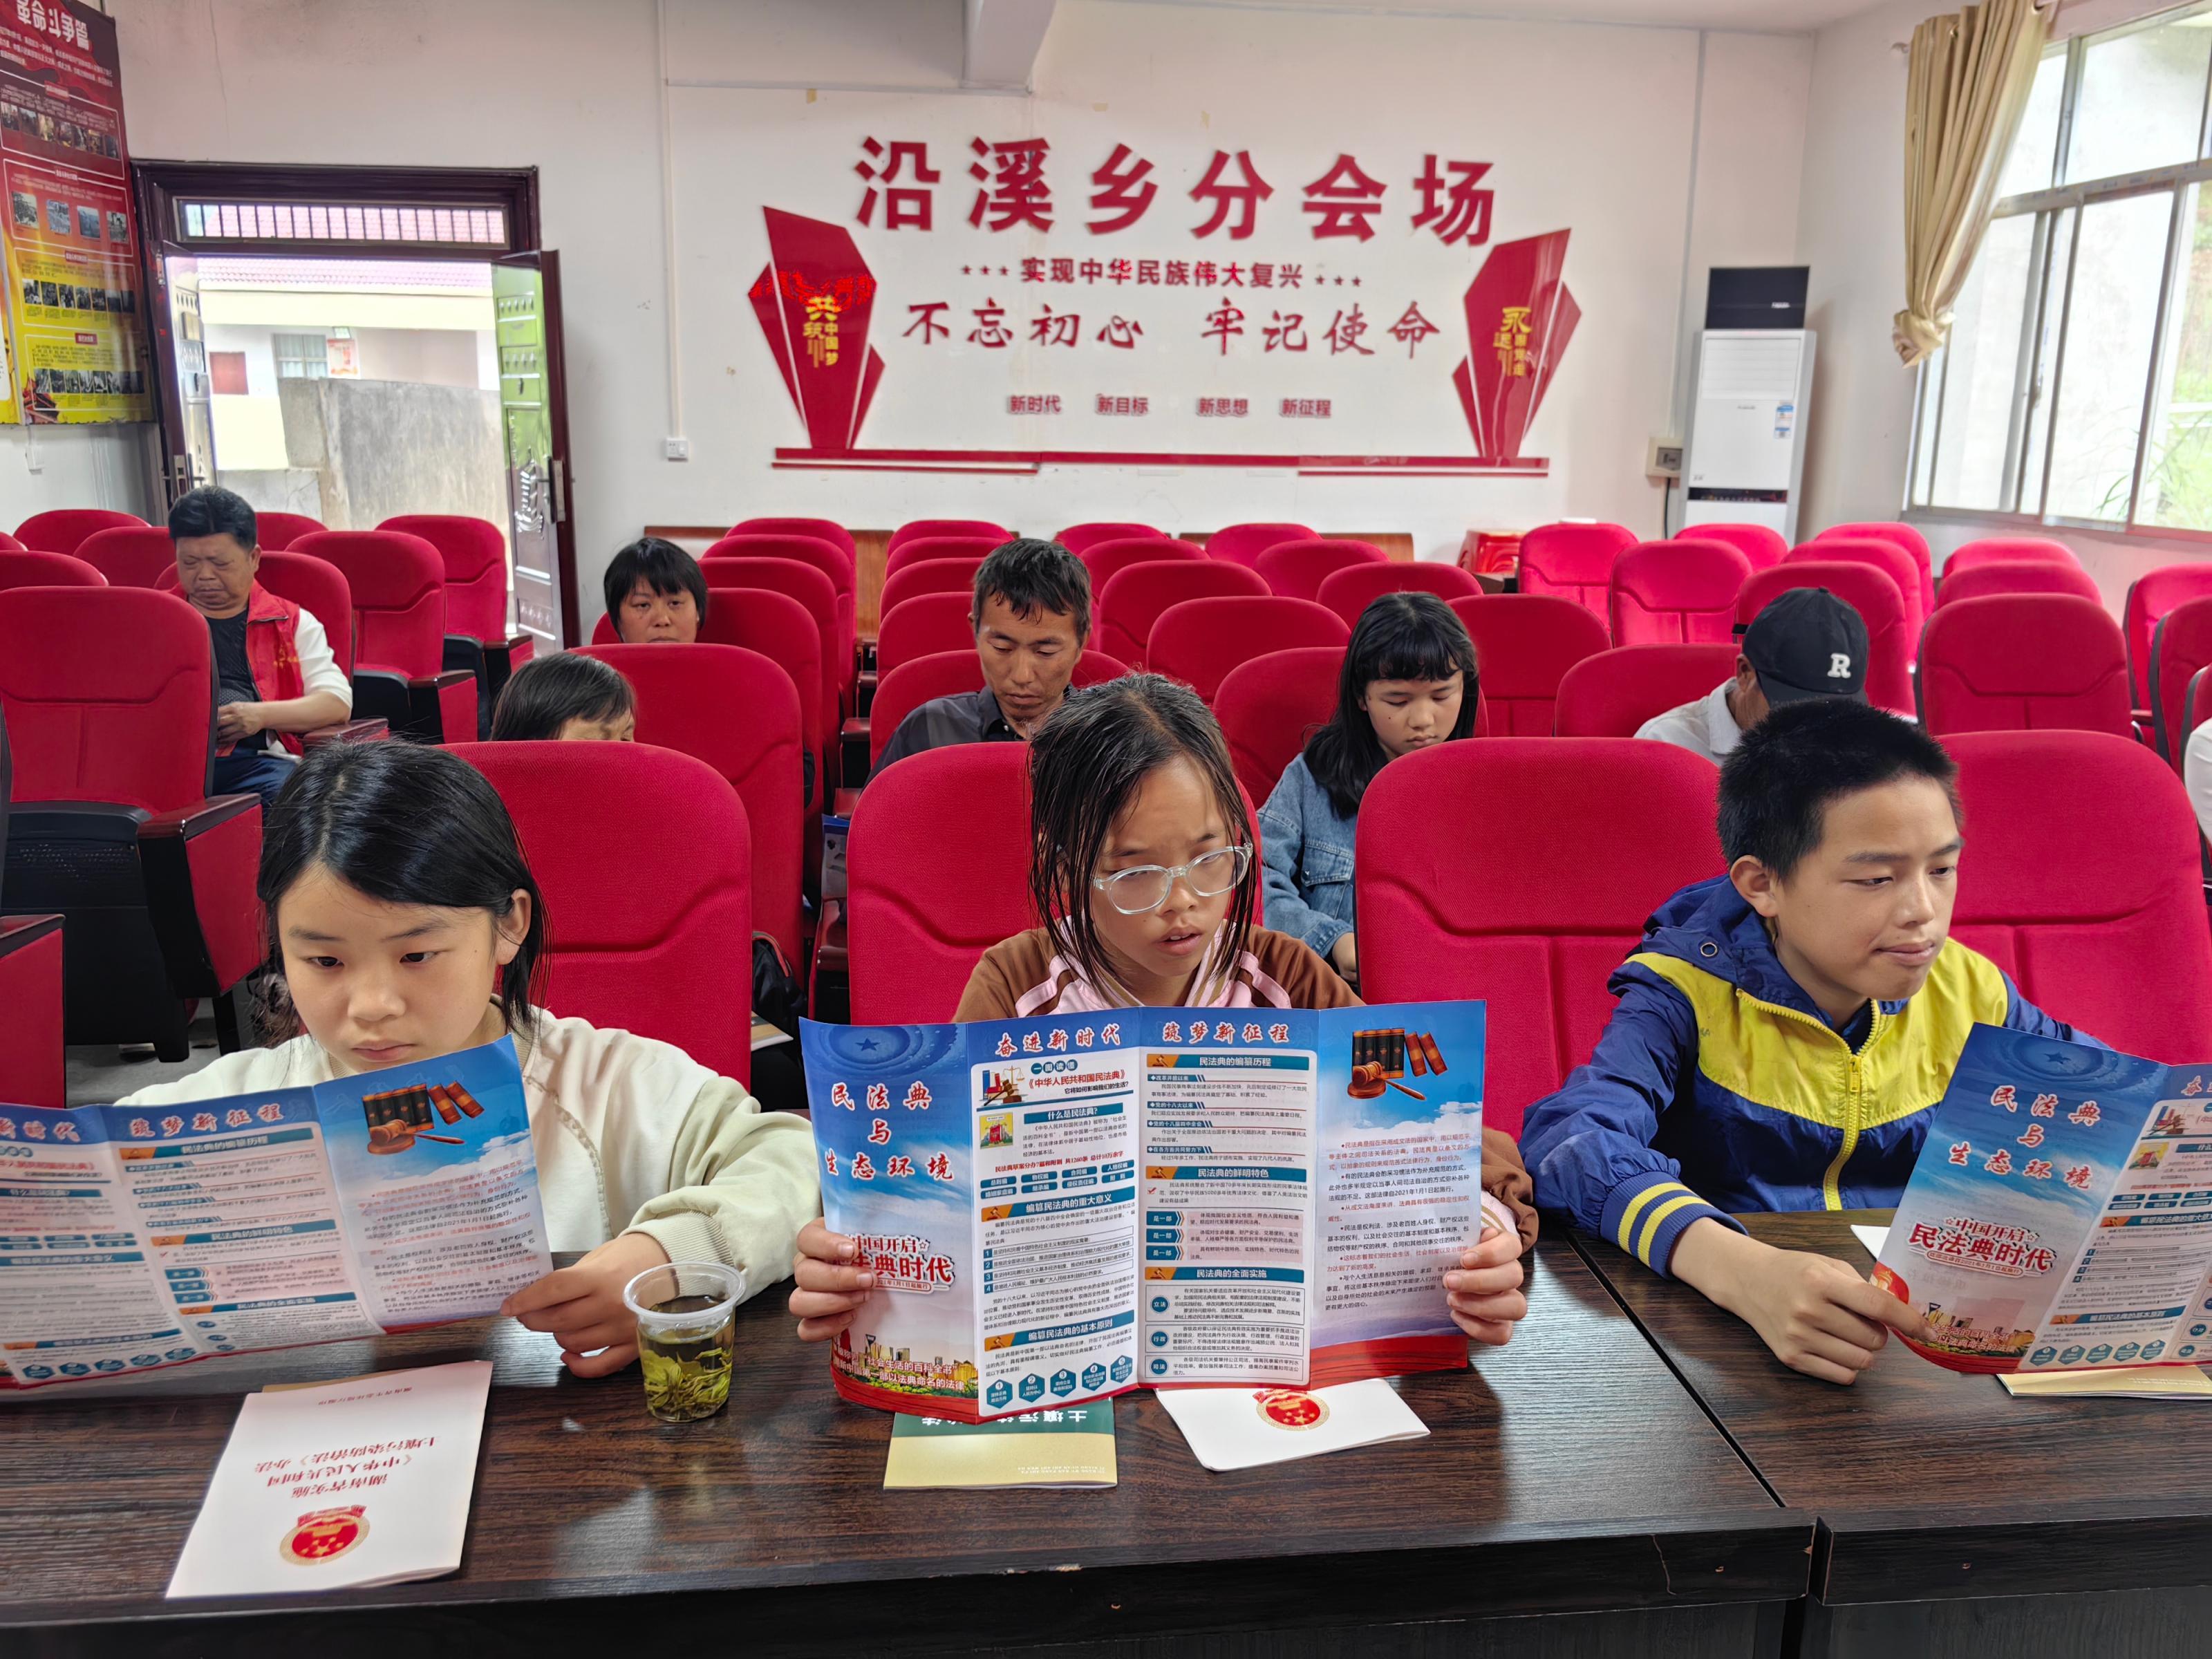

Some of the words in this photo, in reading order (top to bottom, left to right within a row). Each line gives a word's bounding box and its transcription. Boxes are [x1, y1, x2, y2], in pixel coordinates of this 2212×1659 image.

[854, 136, 1494, 246] 沿溪乡分会场
[1020, 257, 1304, 288] 实现中华民族伟大复兴
[902, 297, 1145, 349] 不忘初心
[1201, 297, 1441, 359] 牢记使命
[1009, 394, 1062, 415] 新时代
[1097, 393, 1149, 415] 新目标
[1197, 397, 1249, 417] 新思想
[1280, 398, 1331, 418] 新征程
[1827, 653, 1851, 678] R
[996, 1023, 1121, 1057] 奋进新时代
[1163, 1021, 1290, 1044] 筑梦新征程
[1029, 1069, 1126, 1089] 《中华人民共和国民法典》
[831, 1080, 933, 1112] 民法典
[1991, 1085, 2101, 1126] 民法典
[129, 1103, 284, 1137] 筑梦新征程
[867, 1118, 892, 1145] 与
[2016, 1125, 2045, 1147] 与
[824, 1150, 956, 1181] 生态环境
[1197, 1168, 1269, 1178] 民法典的鲜明特色
[1949, 1141, 2092, 1190] 生态环境
[1956, 1219, 2025, 1242] 中国开启
[852, 1235, 917, 1254] 中国开启
[1909, 1224, 2052, 1271] 民法典时代
[1197, 1269, 1267, 1278] 民法典的全面实施
[290, 1473, 388, 1499] 湖南省实施
